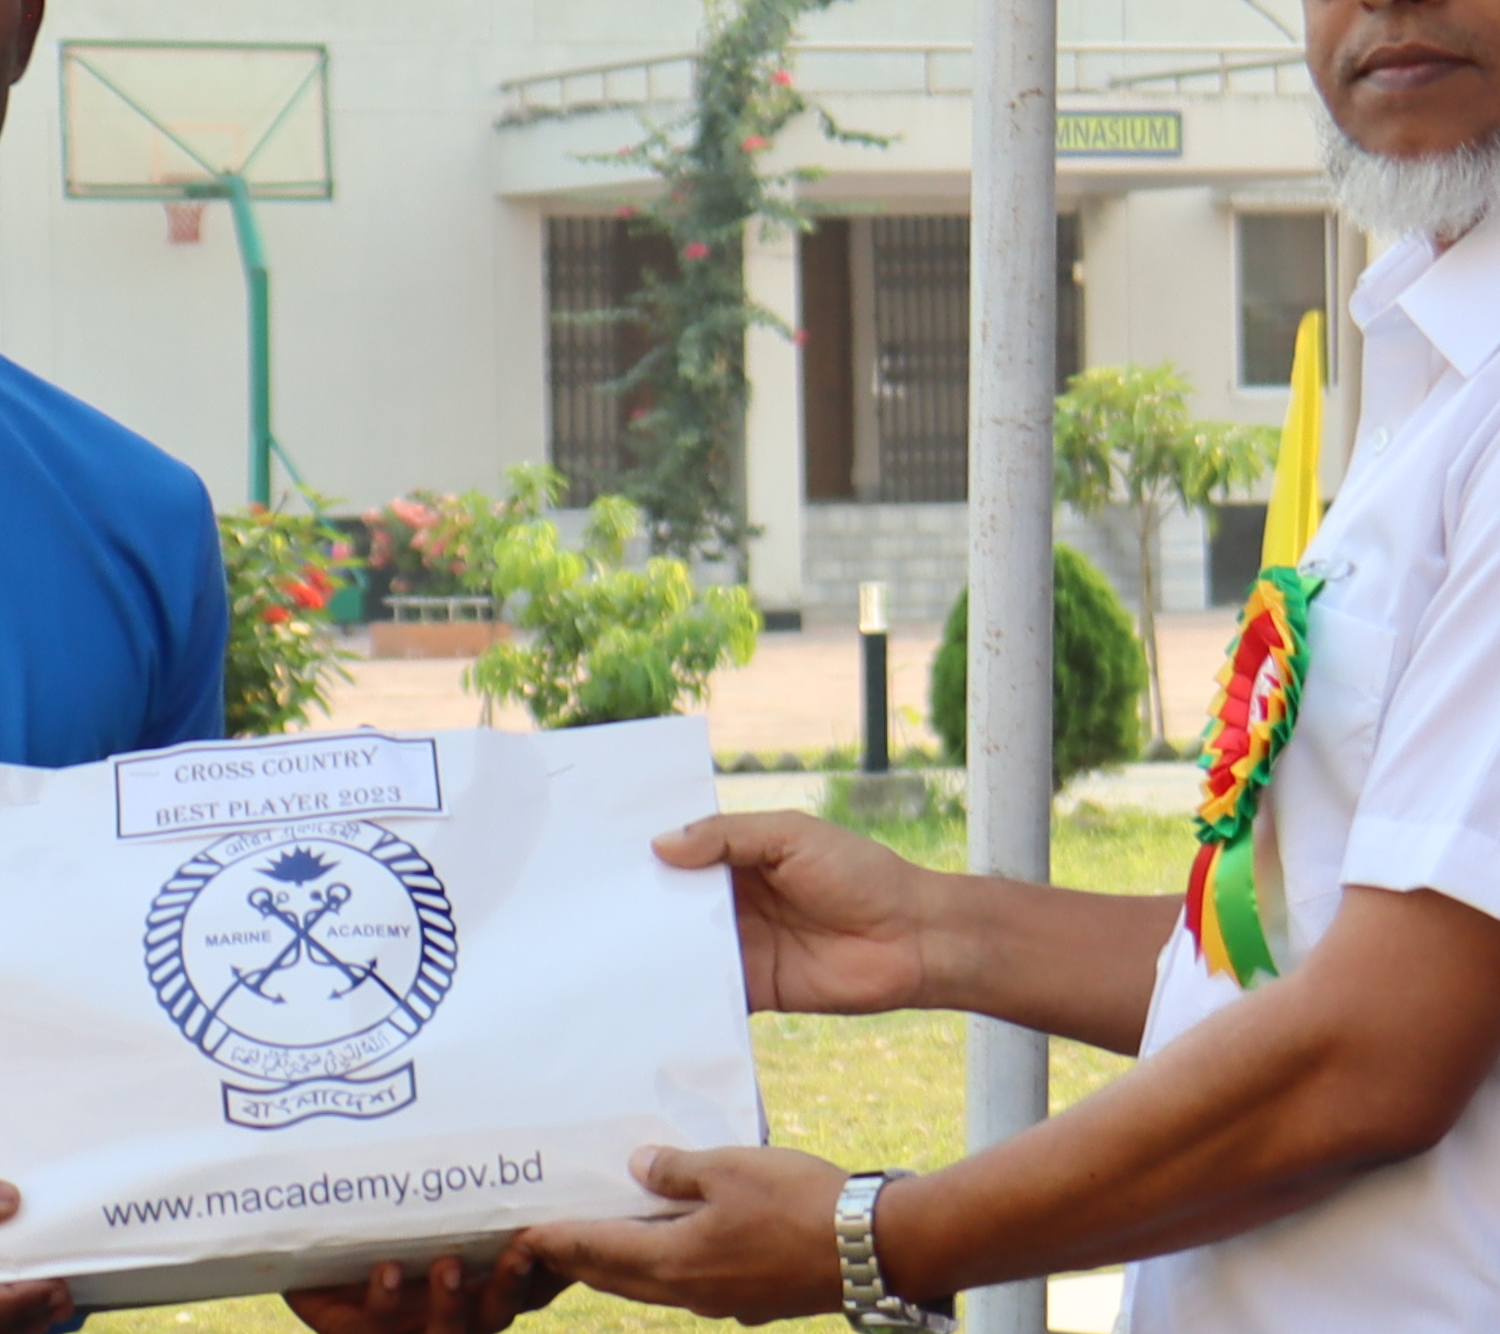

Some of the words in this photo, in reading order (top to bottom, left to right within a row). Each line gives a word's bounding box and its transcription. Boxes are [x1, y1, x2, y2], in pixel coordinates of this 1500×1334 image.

[1056, 118, 1169, 146] MNASIUM
[174, 762, 255, 784] CROSS
[261, 745, 379, 776] COUNTRY
[155, 802, 222, 828] BEST
[228, 792, 330, 818] PLAYER
[338, 785, 403, 807] 2023
[204, 929, 272, 947] MARINE
[326, 923, 412, 939] ACADEMY
[242, 1085, 397, 1119] বাংলাদেশ
[101, 1150, 545, 1228] www.macademy.gov.bd
